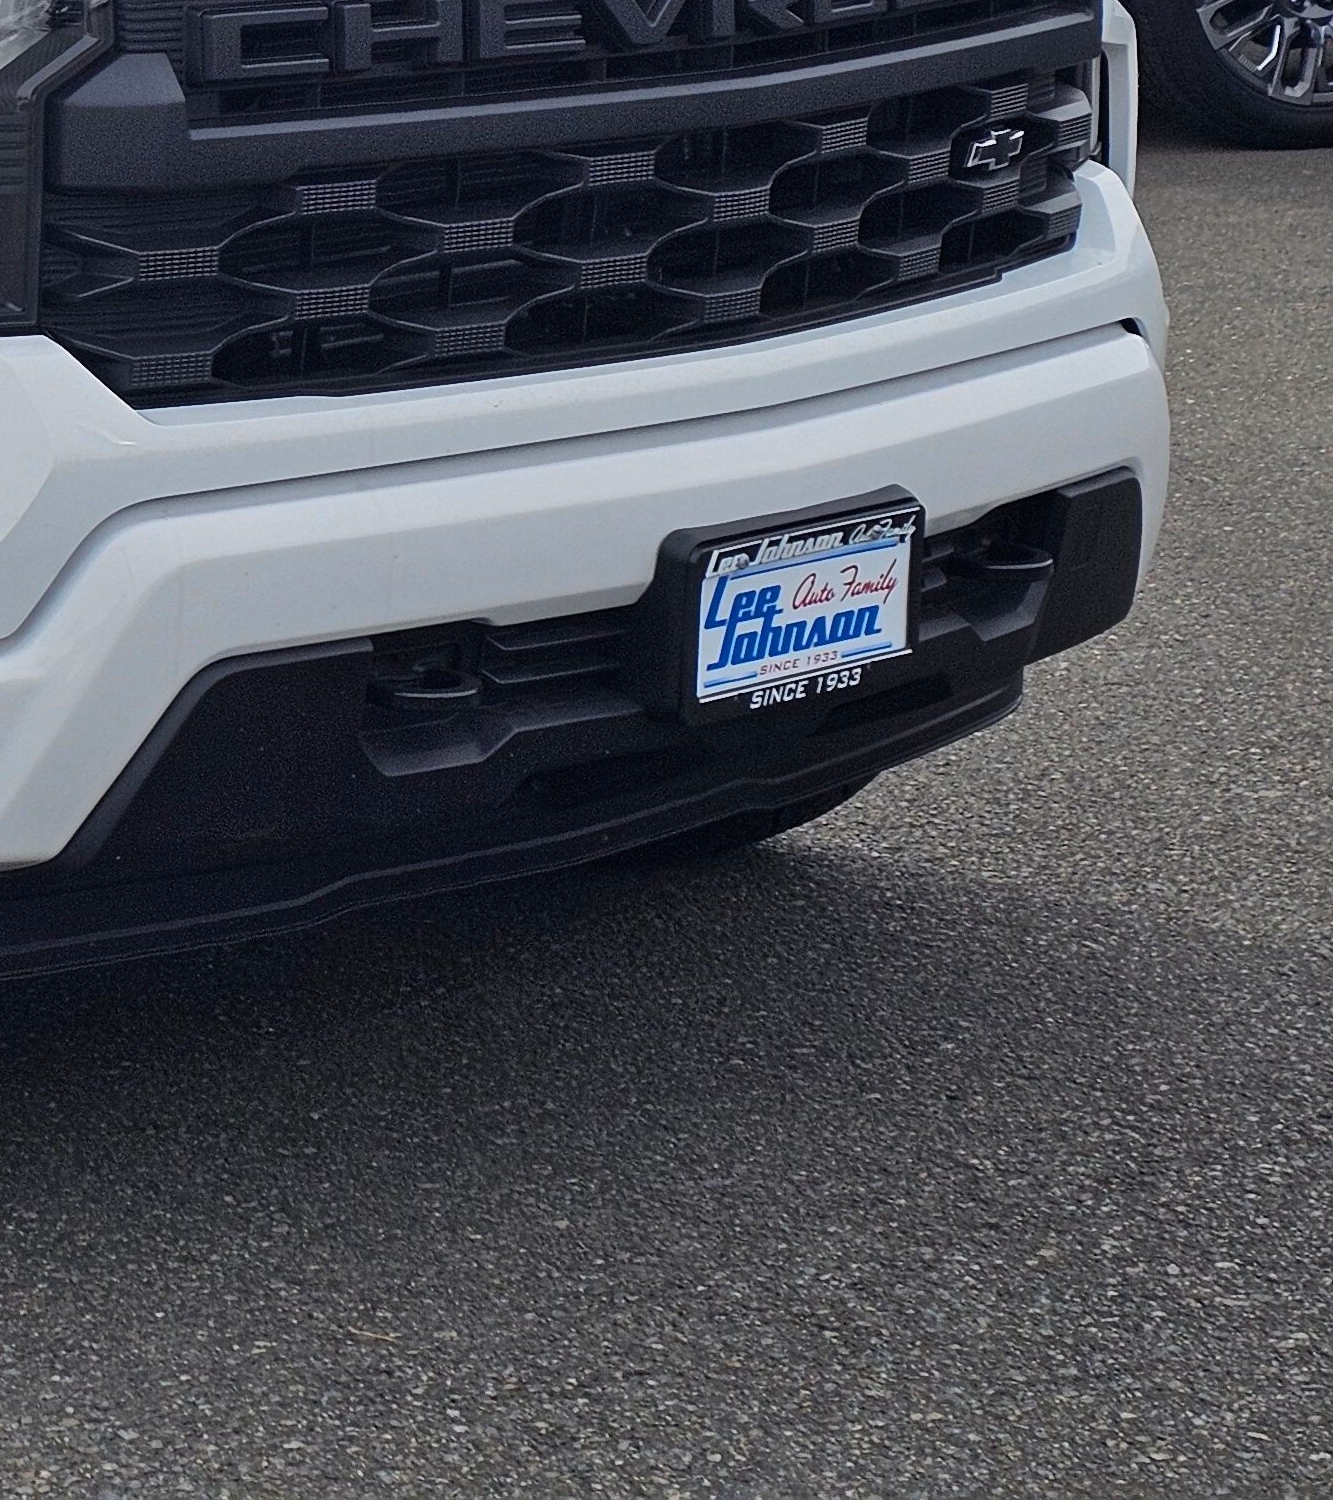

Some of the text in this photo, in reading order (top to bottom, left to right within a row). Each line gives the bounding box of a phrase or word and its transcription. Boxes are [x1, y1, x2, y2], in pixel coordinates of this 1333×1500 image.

[749, 531, 844, 567] Johnson
[704, 575, 783, 630] Lee
[792, 558, 898, 610] Auto Family
[706, 604, 882, 671] Johnson
[759, 651, 838, 676] SINCE 1933
[749, 668, 862, 709] SINCE 1933
